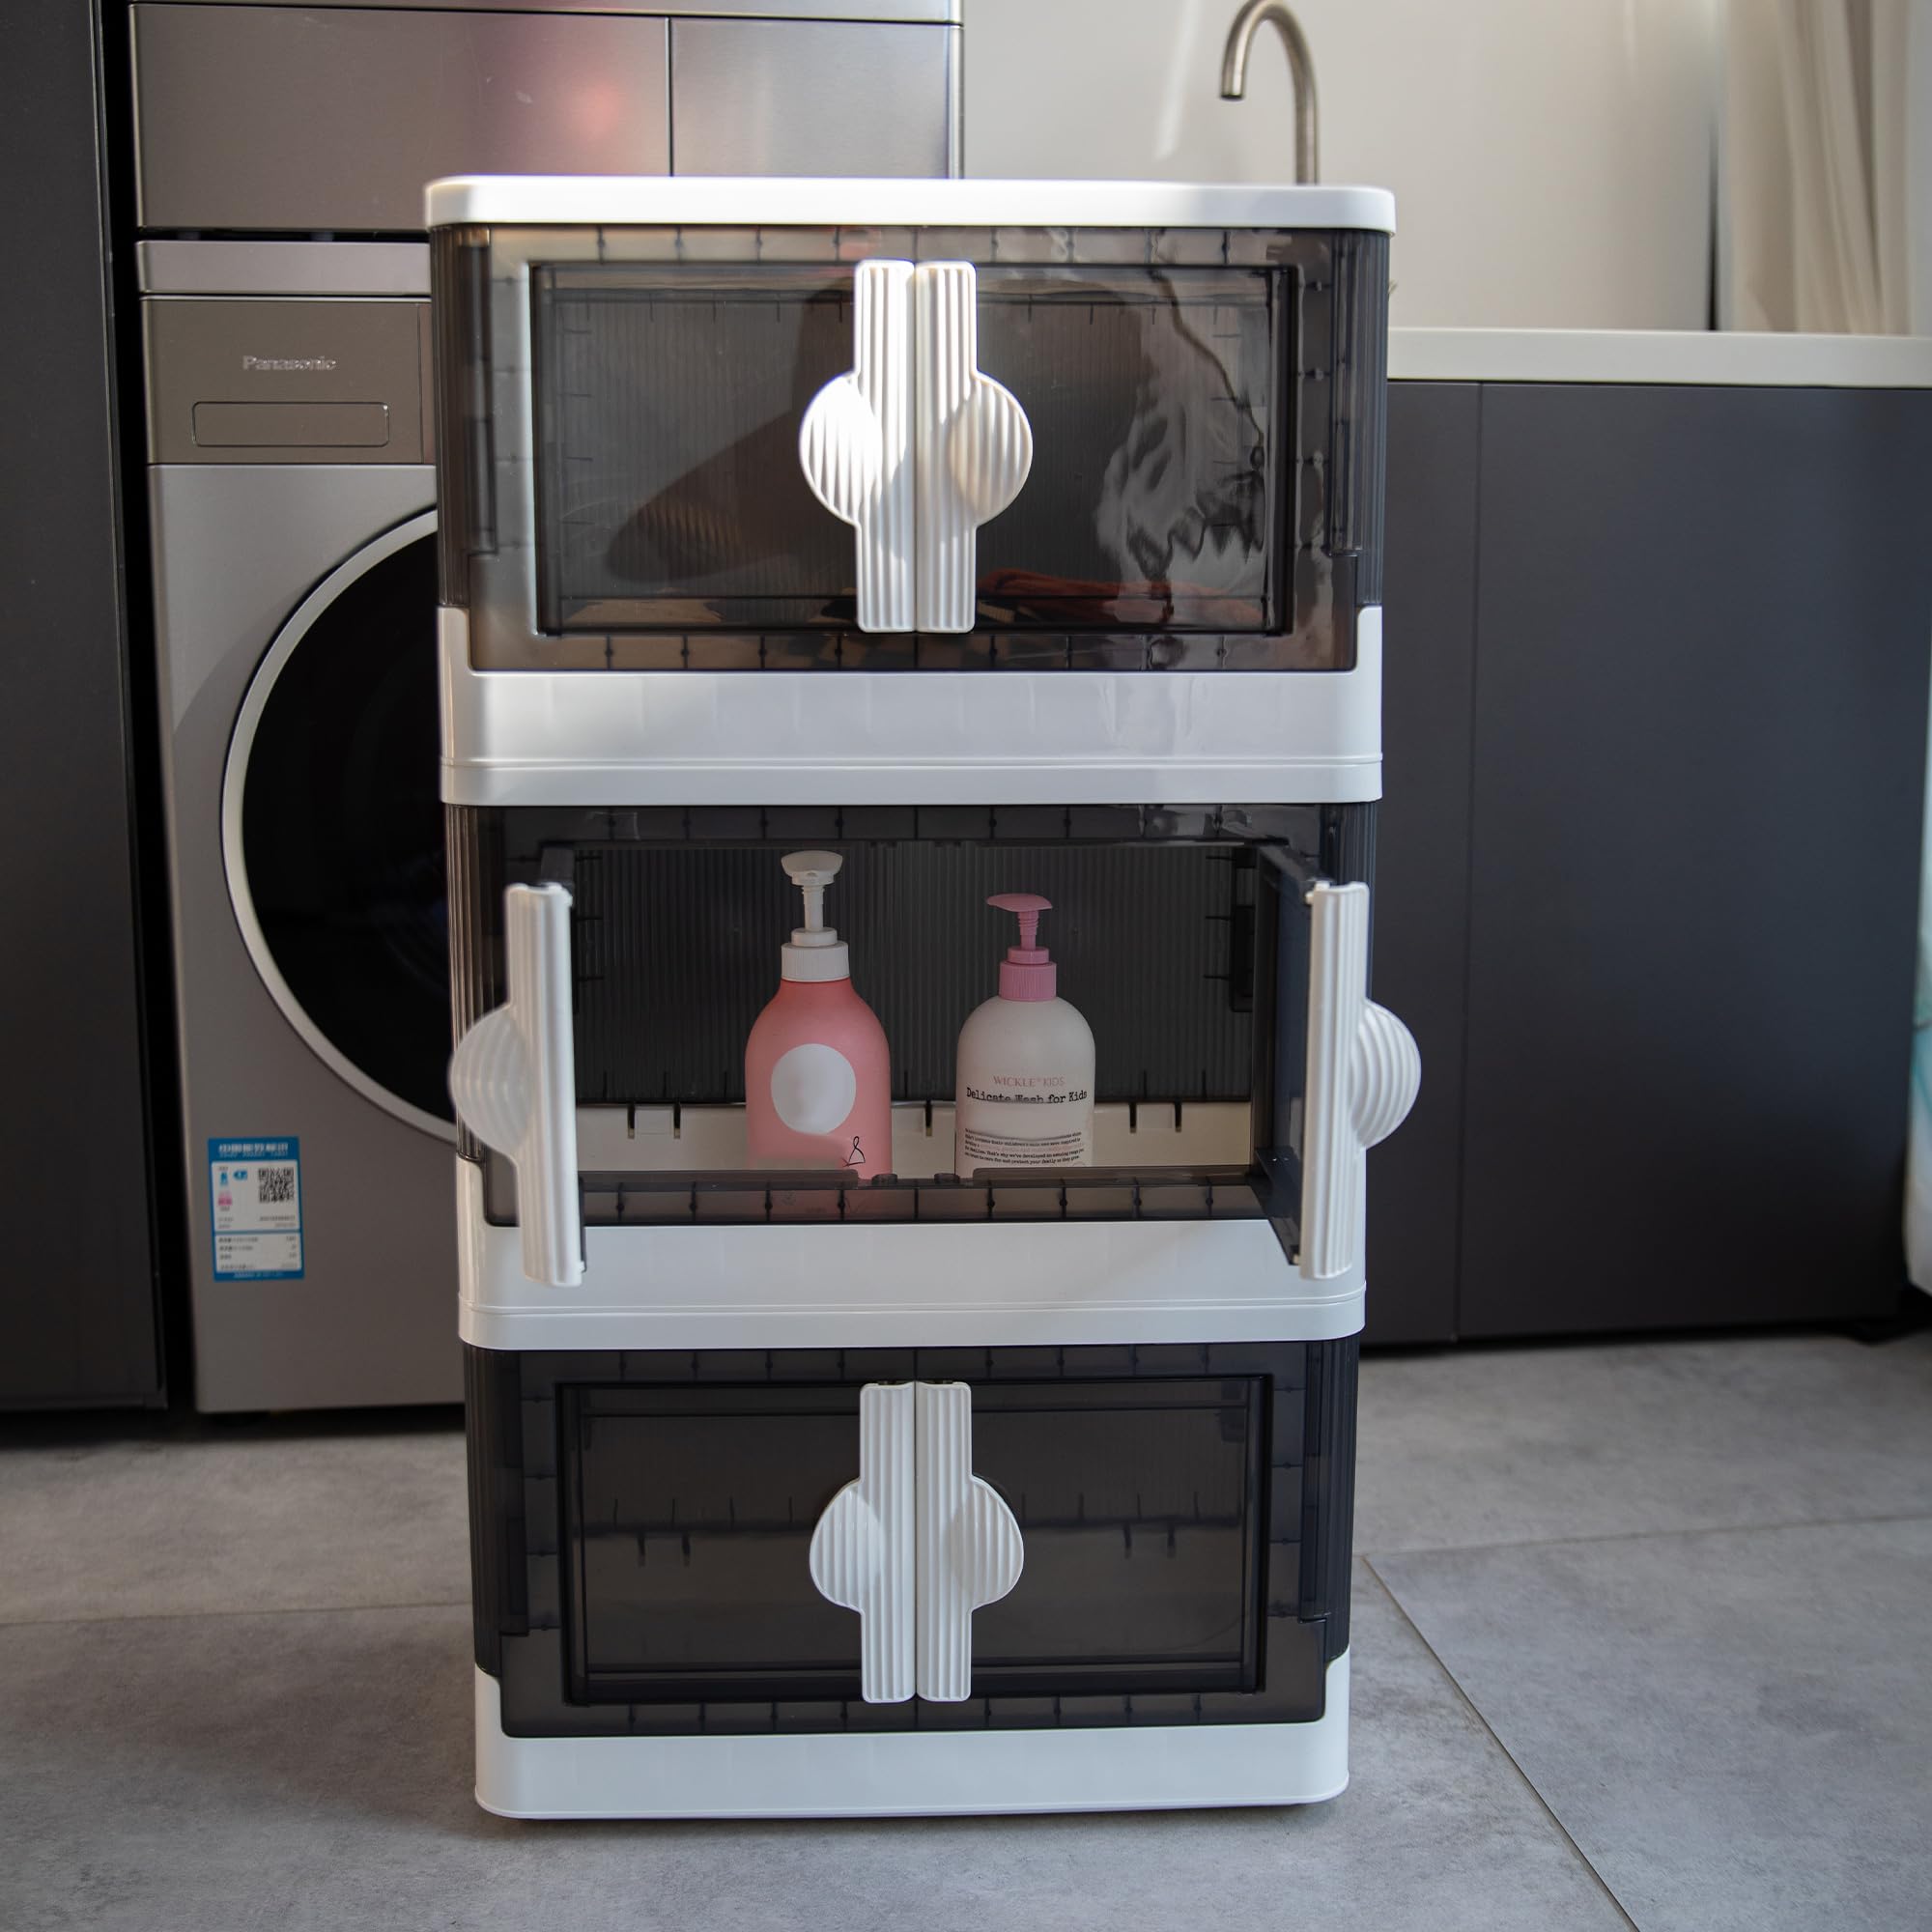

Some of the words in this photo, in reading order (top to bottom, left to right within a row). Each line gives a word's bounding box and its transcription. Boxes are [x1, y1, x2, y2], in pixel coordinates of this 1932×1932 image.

[242, 355, 336, 371] Panasonic
[1043, 1076, 1065, 1088] KIDS
[966, 1087, 1011, 1103] Delicate
[1047, 1094, 1066, 1104] for
[1068, 1090, 1088, 1102] Kids
